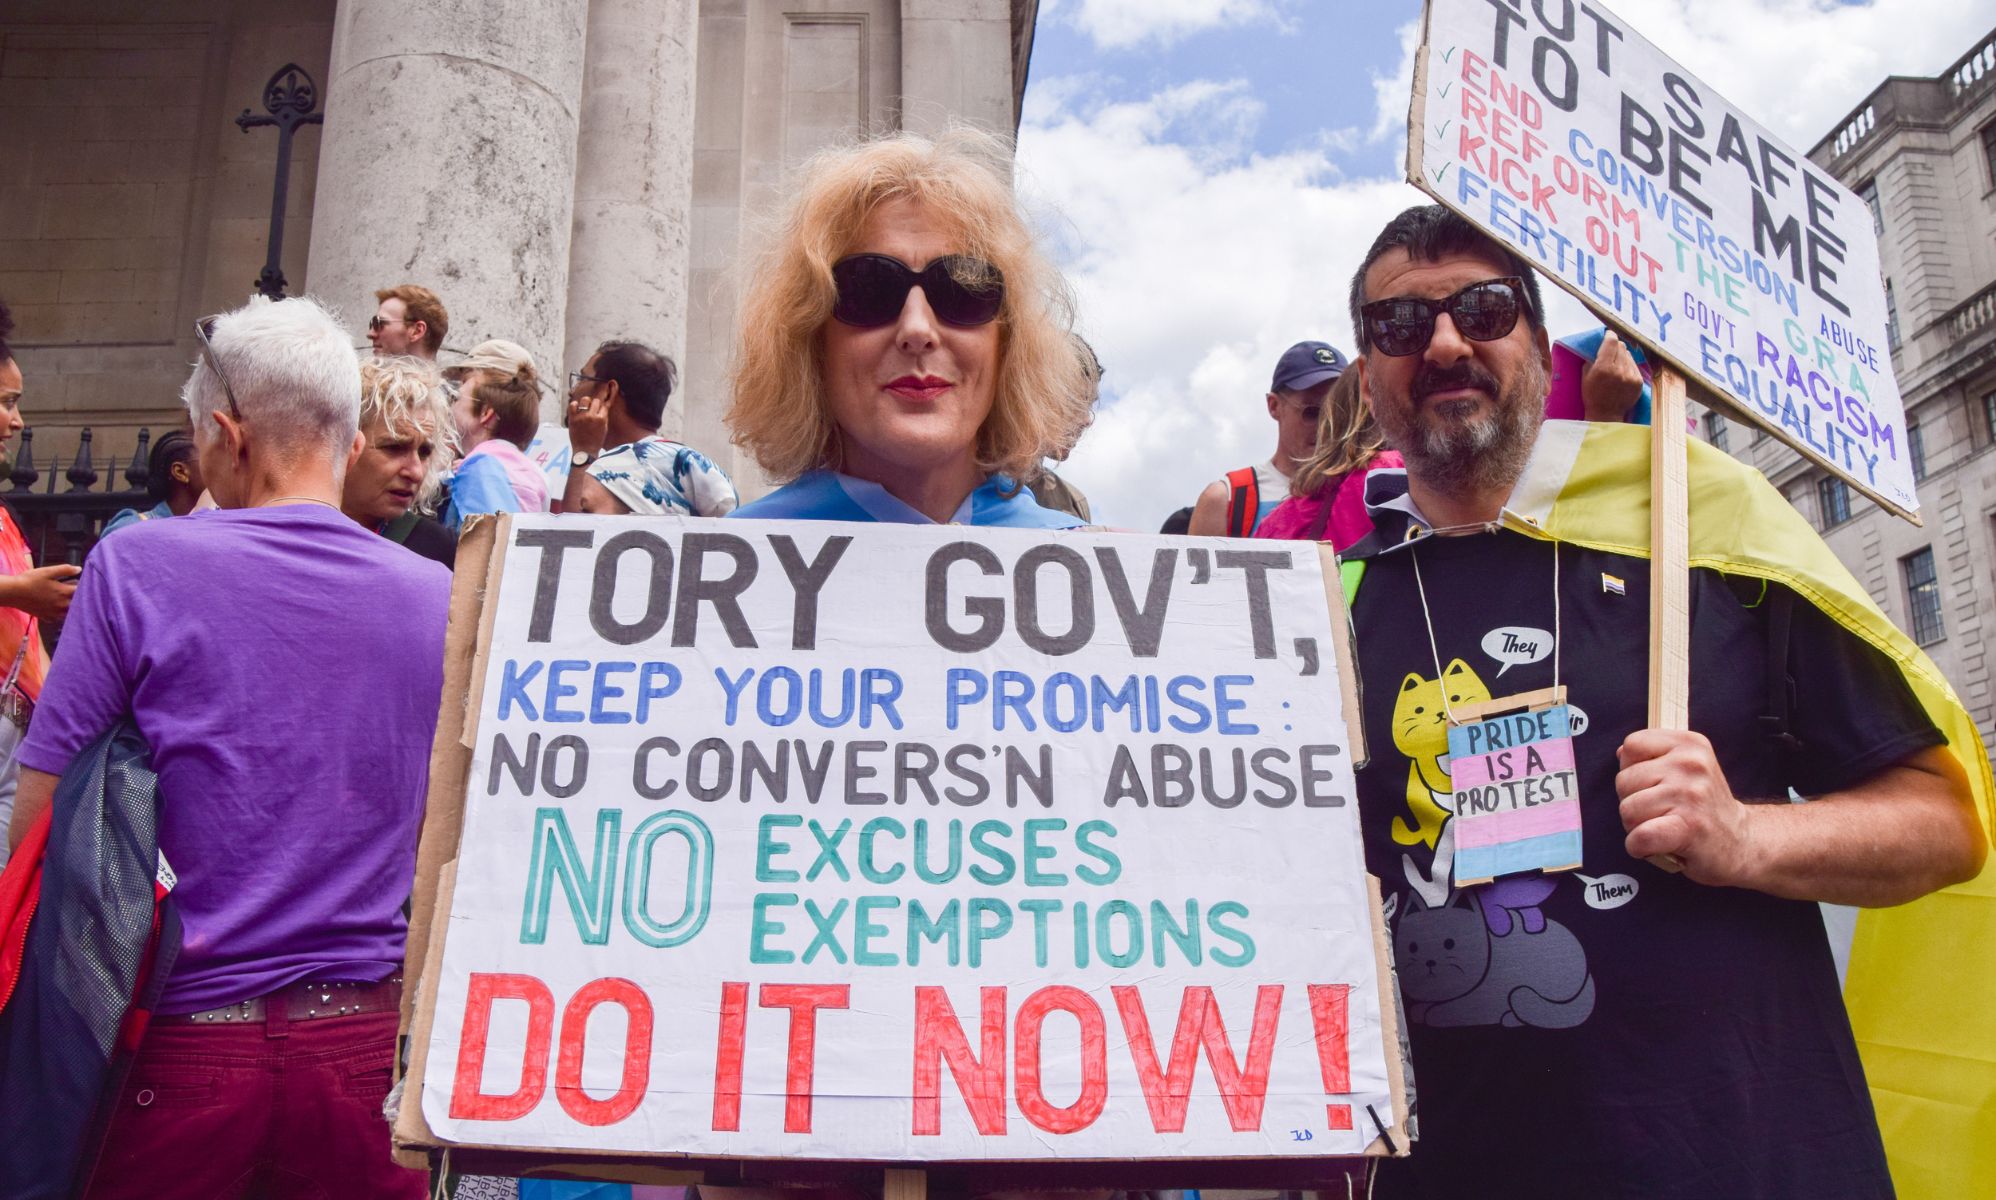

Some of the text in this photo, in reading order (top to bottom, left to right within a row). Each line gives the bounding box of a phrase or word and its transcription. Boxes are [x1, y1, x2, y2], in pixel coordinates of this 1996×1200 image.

[1486, 0, 1851, 318] TO BE ME
[1507, 0, 1847, 252] OT SAFE
[1461, 87, 1640, 242] REFORM
[1667, 232, 1750, 316] THE
[1461, 48, 1880, 374] END CONVERSION ABUSE
[1457, 166, 1879, 487] FERTILITY EQUALITY
[1459, 124, 1896, 460] KICK OUT GOV'T RACISM
[515, 528, 1319, 676] TORY GOV'T,
[1501, 632, 1538, 658] They
[497, 659, 682, 724] KEEP
[714, 666, 904, 730] YOUR
[1468, 710, 1552, 754] PRIDE
[1486, 746, 1546, 781] IS A
[487, 732, 1346, 809] NO CONVERS'N ABUSE
[1456, 771, 1574, 816] PROTEST
[519, 807, 1122, 948] NO EXCUSES
[749, 892, 1256, 969] EXEMPTIONS
[1592, 881, 1633, 903] Them
[448, 972, 1353, 1137] DO IT NOW!
